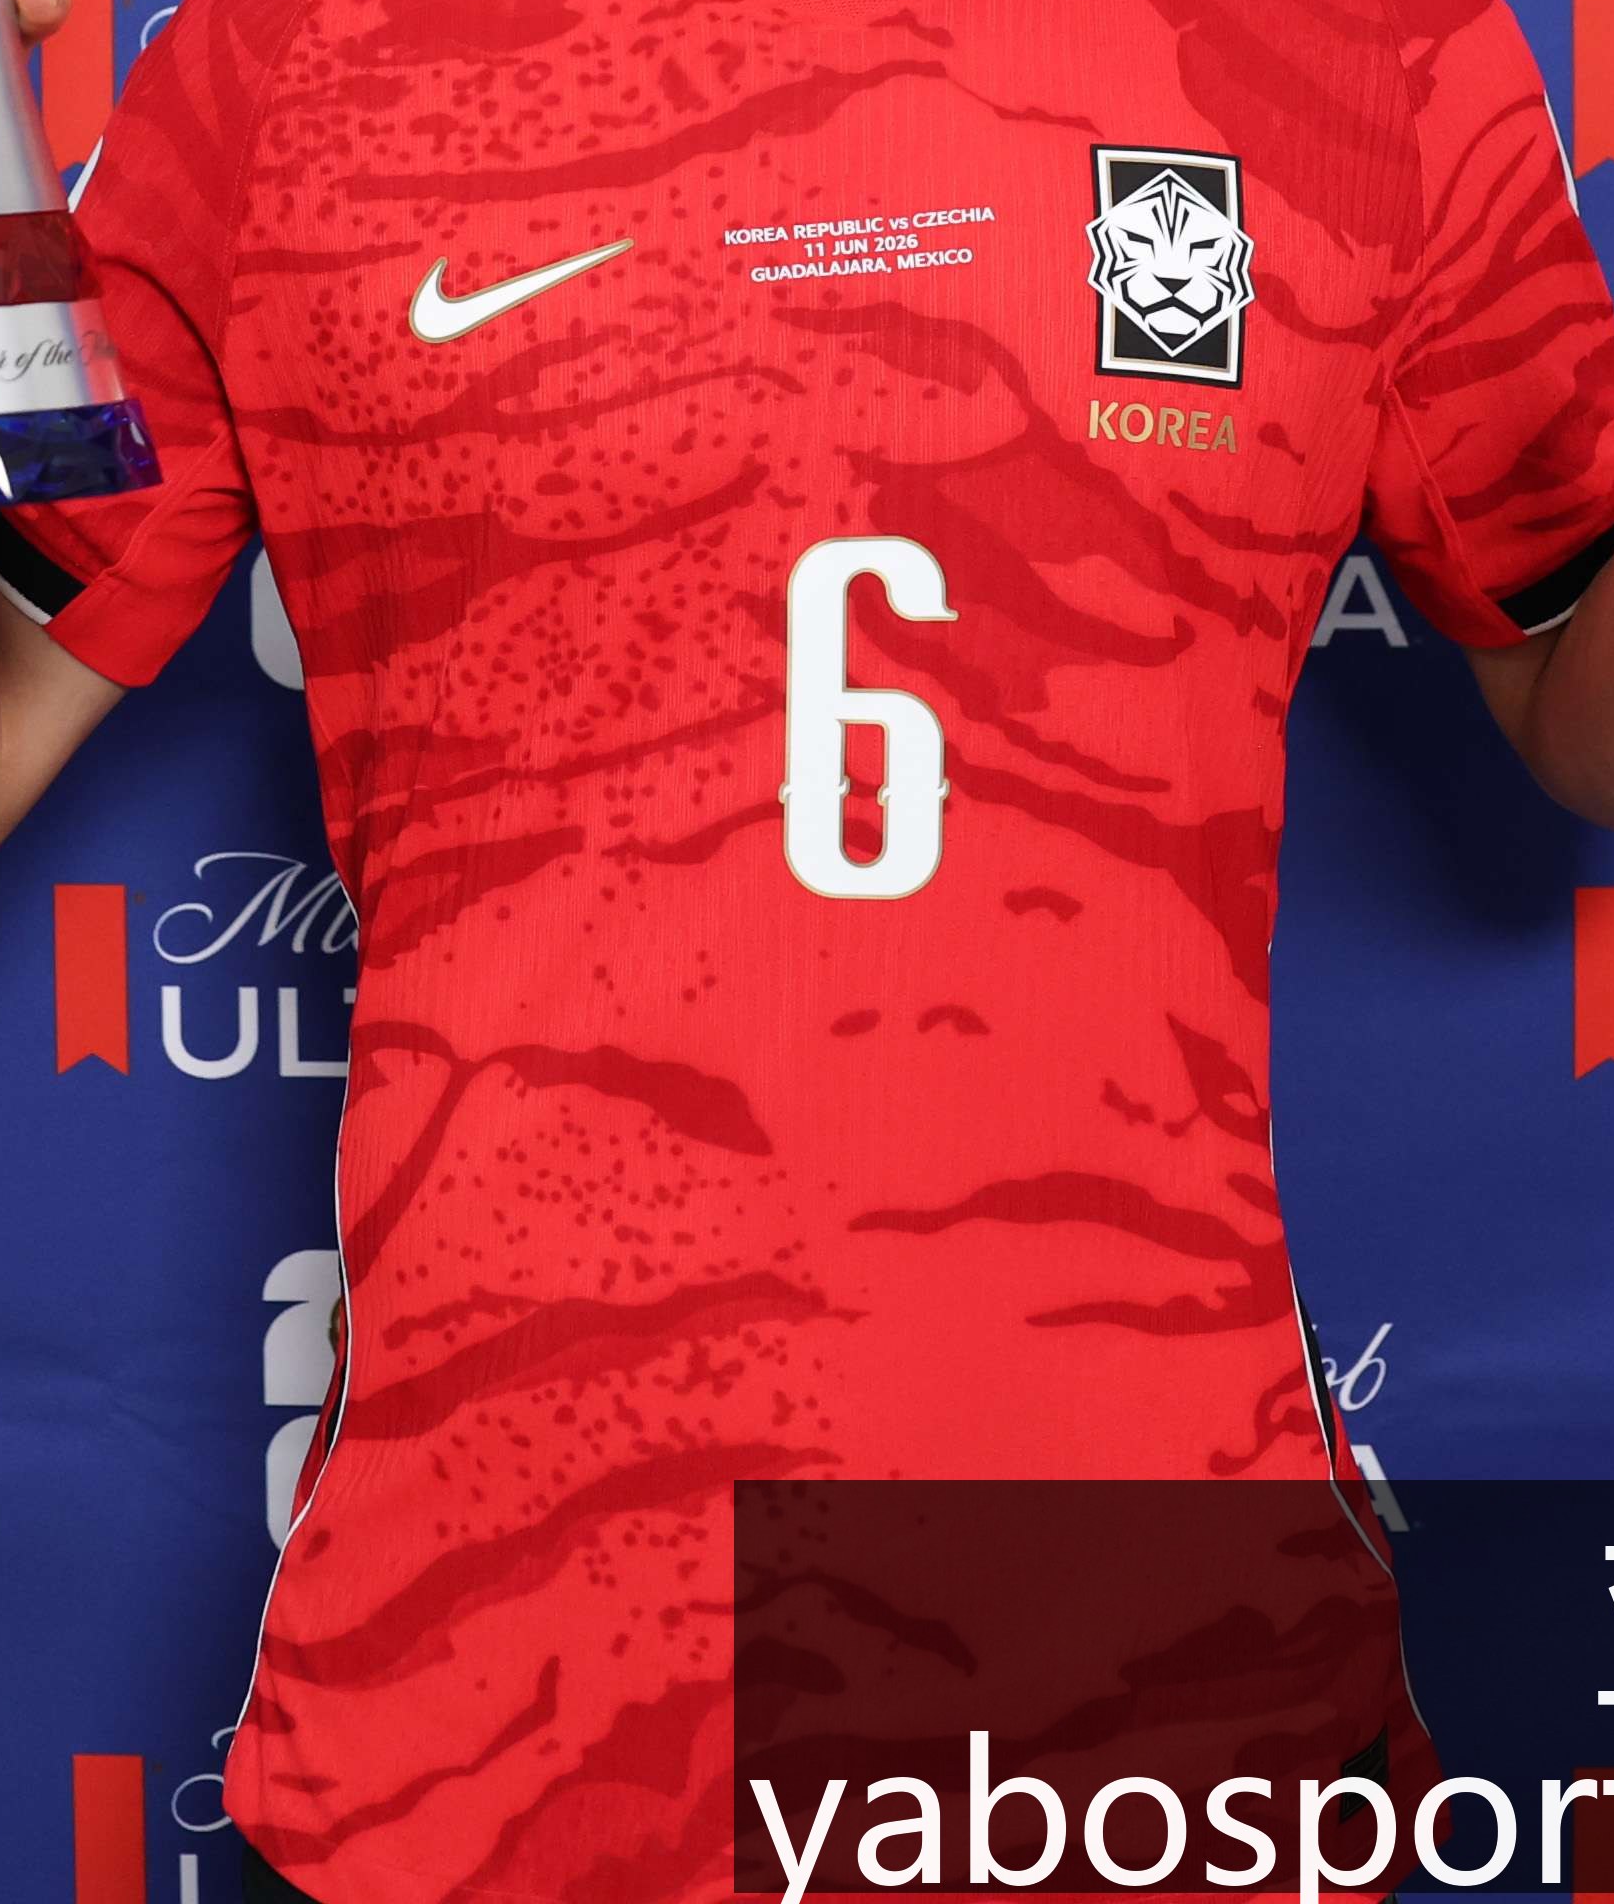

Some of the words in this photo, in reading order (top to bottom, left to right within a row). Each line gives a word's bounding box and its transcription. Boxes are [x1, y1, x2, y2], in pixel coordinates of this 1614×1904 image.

[724, 226, 788, 245] KOREA
[793, 216, 884, 239] REPUBLIC
[889, 217, 909, 231] vs
[912, 206, 995, 229] CZECHIA
[804, 242, 825, 258] 11
[832, 238, 869, 256] JUN
[873, 233, 919, 253] 2026
[750, 256, 892, 283] GUADALAJARA,
[896, 248, 973, 270] MEXICO
[1088, 399, 1238, 453] KOREA
[779, 536, 959, 900] 6
